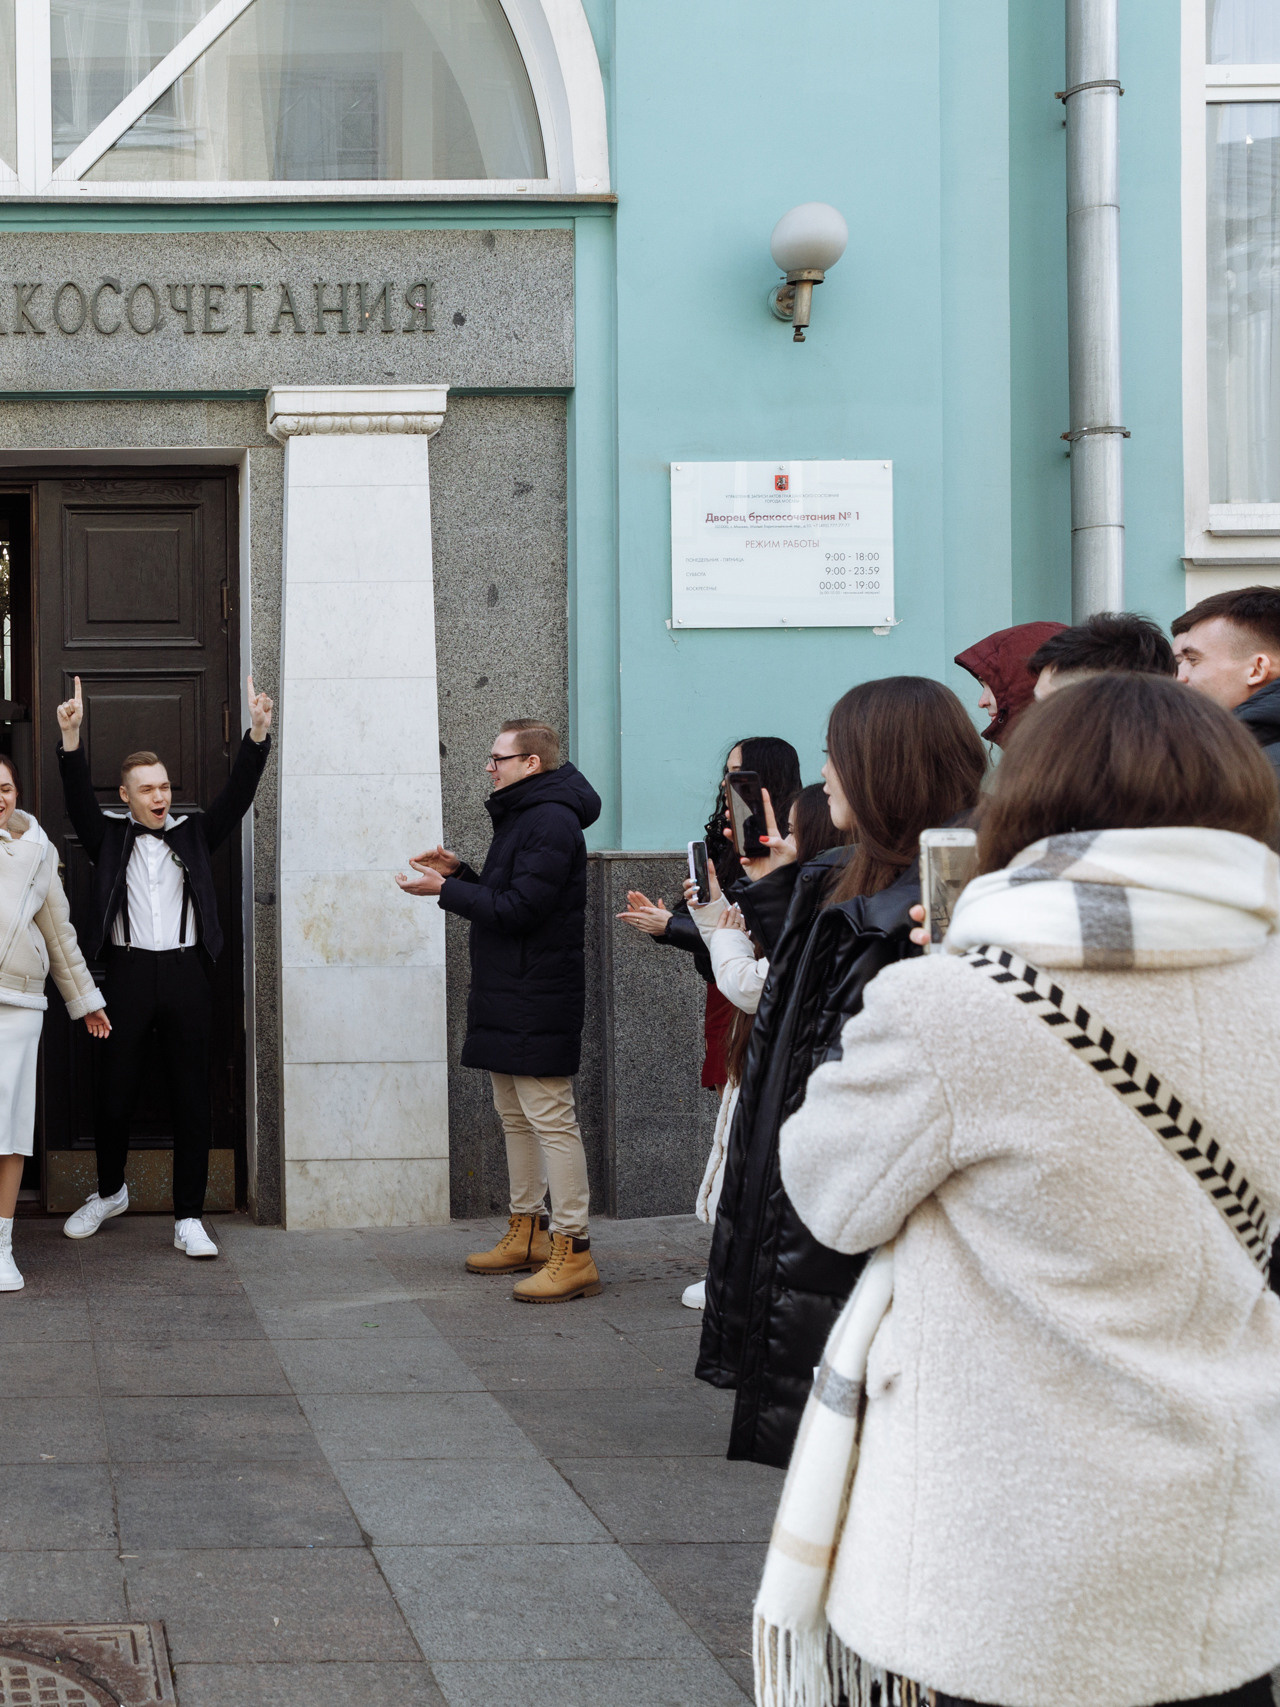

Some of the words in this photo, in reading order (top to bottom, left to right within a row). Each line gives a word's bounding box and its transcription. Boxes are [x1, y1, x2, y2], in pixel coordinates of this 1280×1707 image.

[705, 512, 746, 524] Дворец
[748, 511, 836, 524] бракосочетания
[745, 539, 780, 549] РЕЖИМ
[783, 539, 820, 548] РАБОТЫ
[824, 552, 846, 562] 9:00
[855, 552, 880, 561] 18:00
[825, 566, 846, 576] 9:00
[853, 566, 880, 576] 23:59
[819, 581, 847, 590] 00:00
[855, 580, 880, 590] 19:00
